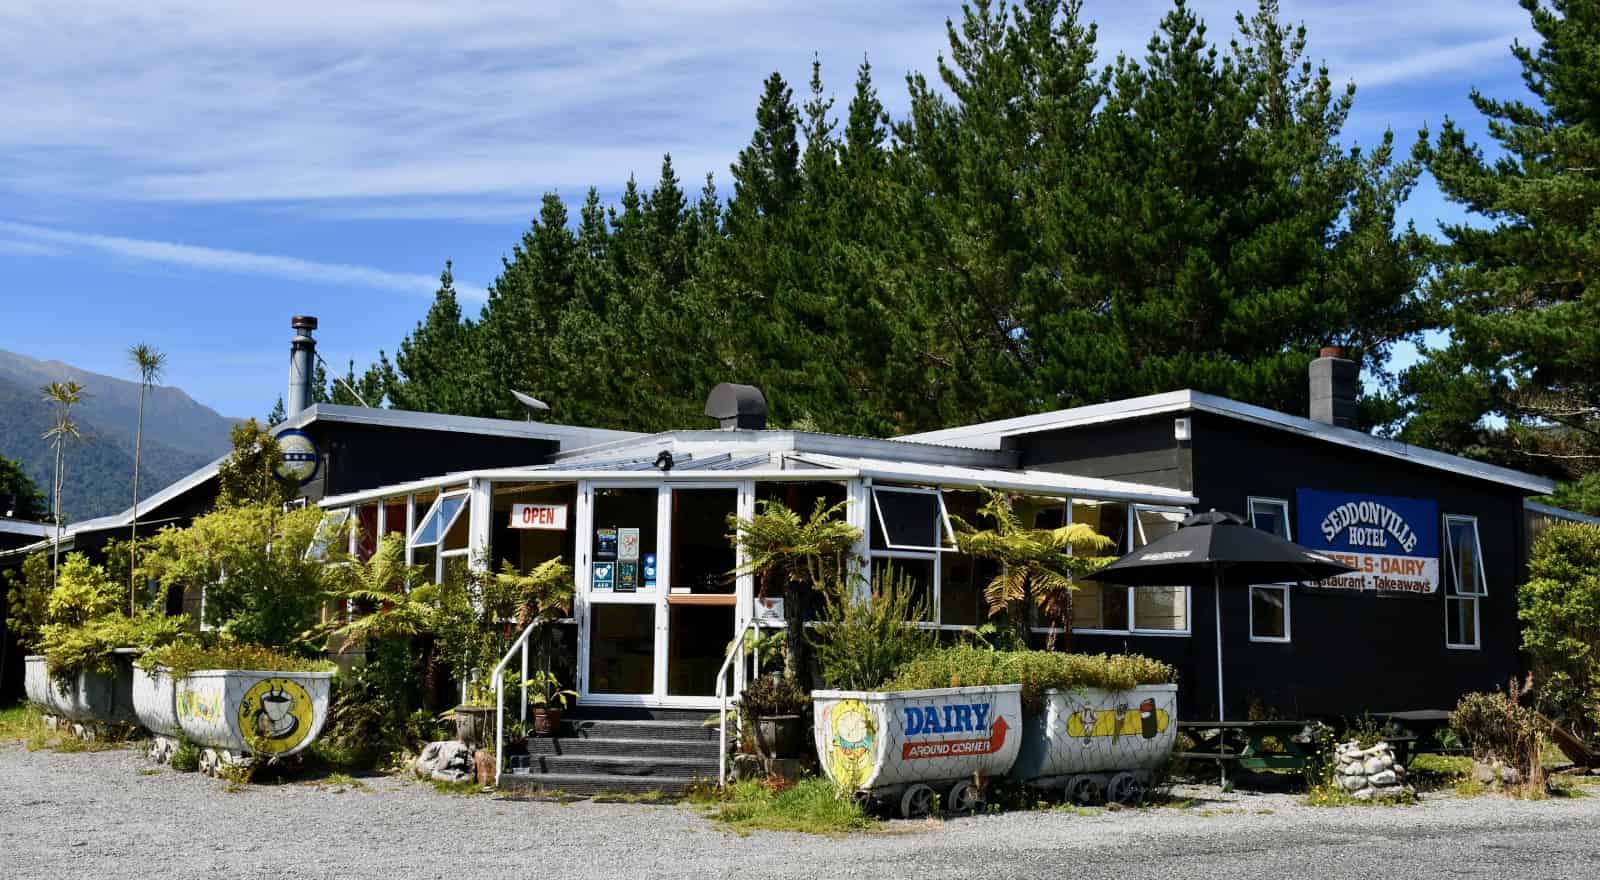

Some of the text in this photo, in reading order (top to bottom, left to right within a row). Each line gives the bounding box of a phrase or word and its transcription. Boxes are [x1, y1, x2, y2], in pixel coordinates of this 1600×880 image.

[523, 507, 554, 524] OPEN
[1321, 501, 1417, 553] SEDDONVILLE
[1348, 526, 1387, 547] HOTEL
[1381, 557, 1425, 575] DAIRY
[1373, 575, 1430, 592] Takeaways
[904, 704, 990, 736] DAIRY
[908, 740, 991, 756] AROUND CORNER
